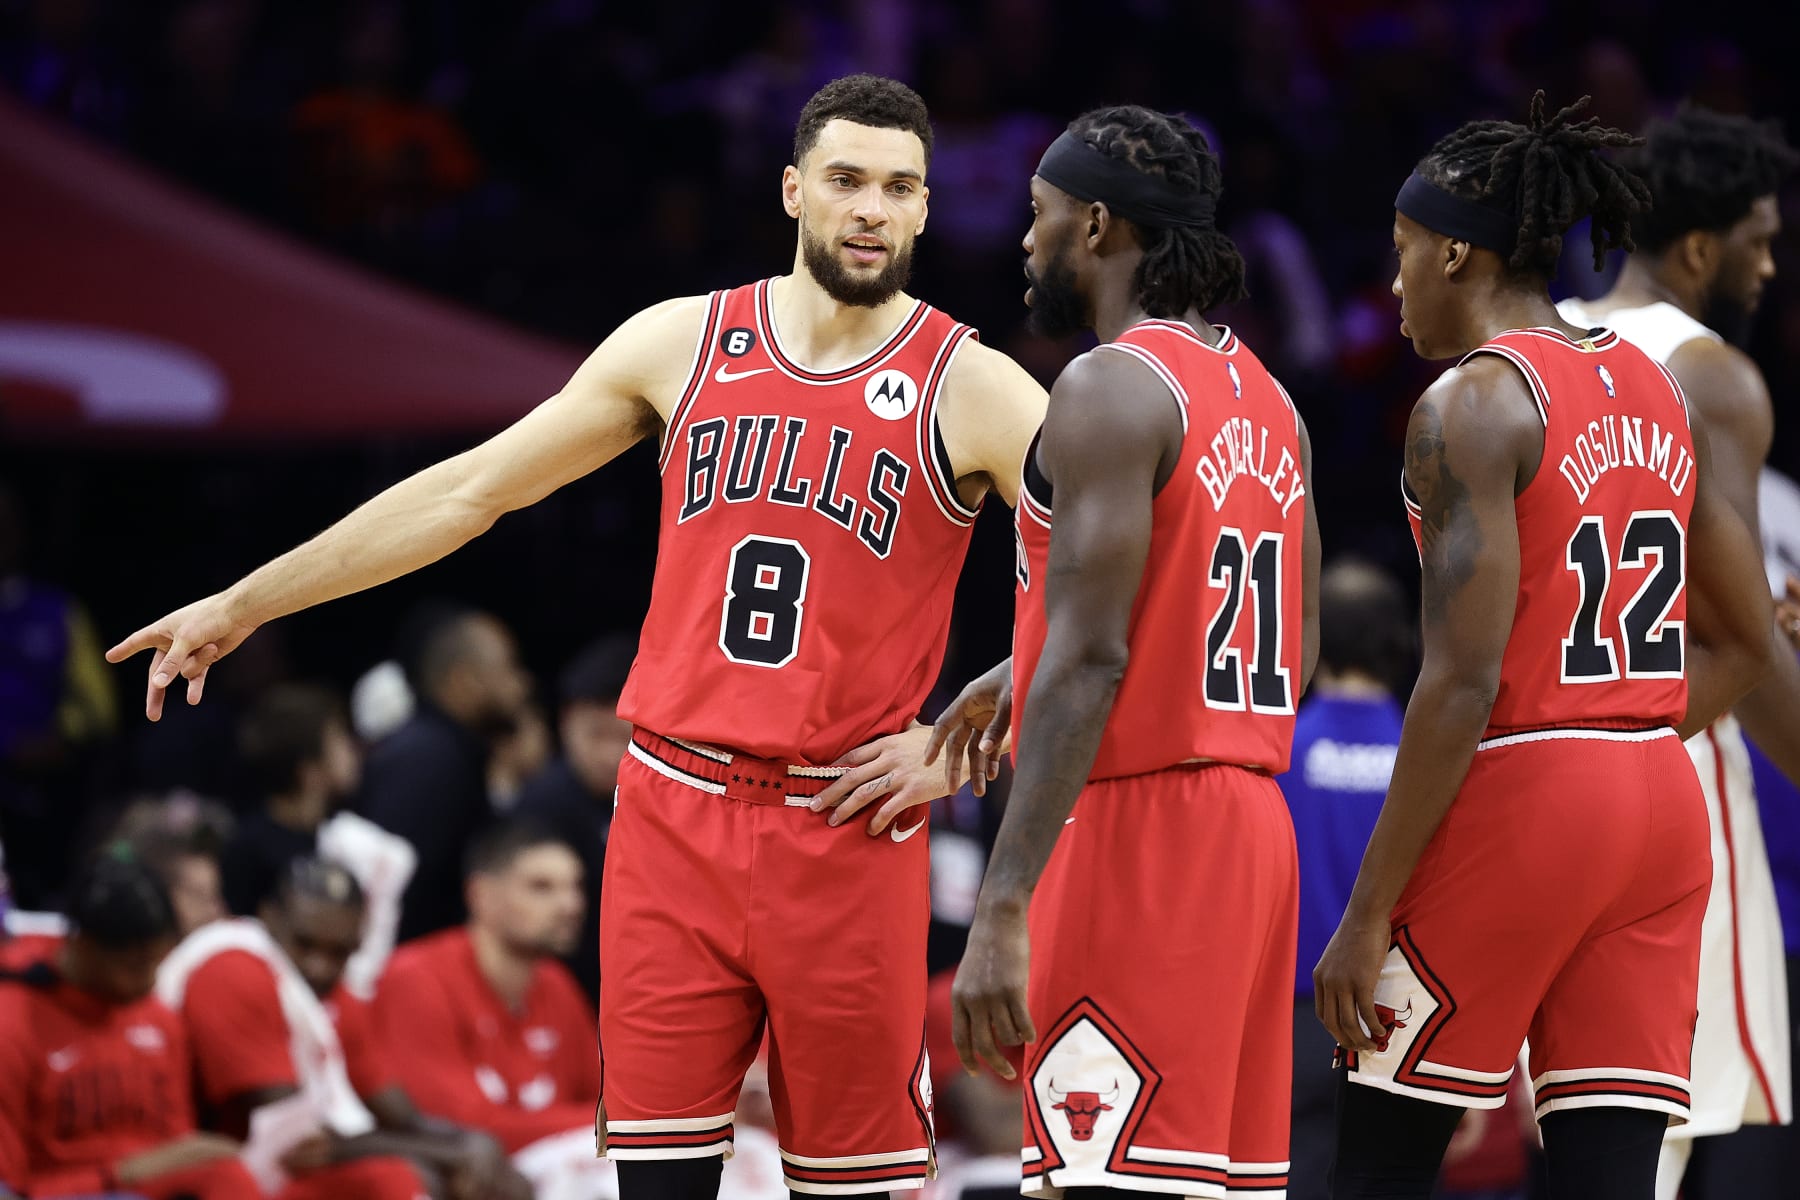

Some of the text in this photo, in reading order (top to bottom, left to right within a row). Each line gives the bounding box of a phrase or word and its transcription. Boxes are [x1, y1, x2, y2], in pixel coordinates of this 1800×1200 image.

[727, 331, 749, 354] 6
[677, 415, 911, 560] BULLS
[1196, 417, 1306, 519] BEVERLEY
[1559, 415, 1693, 505] DOSUNMU
[718, 533, 811, 669] 8
[1203, 525, 1296, 716] 21
[1560, 510, 1685, 684] 12
